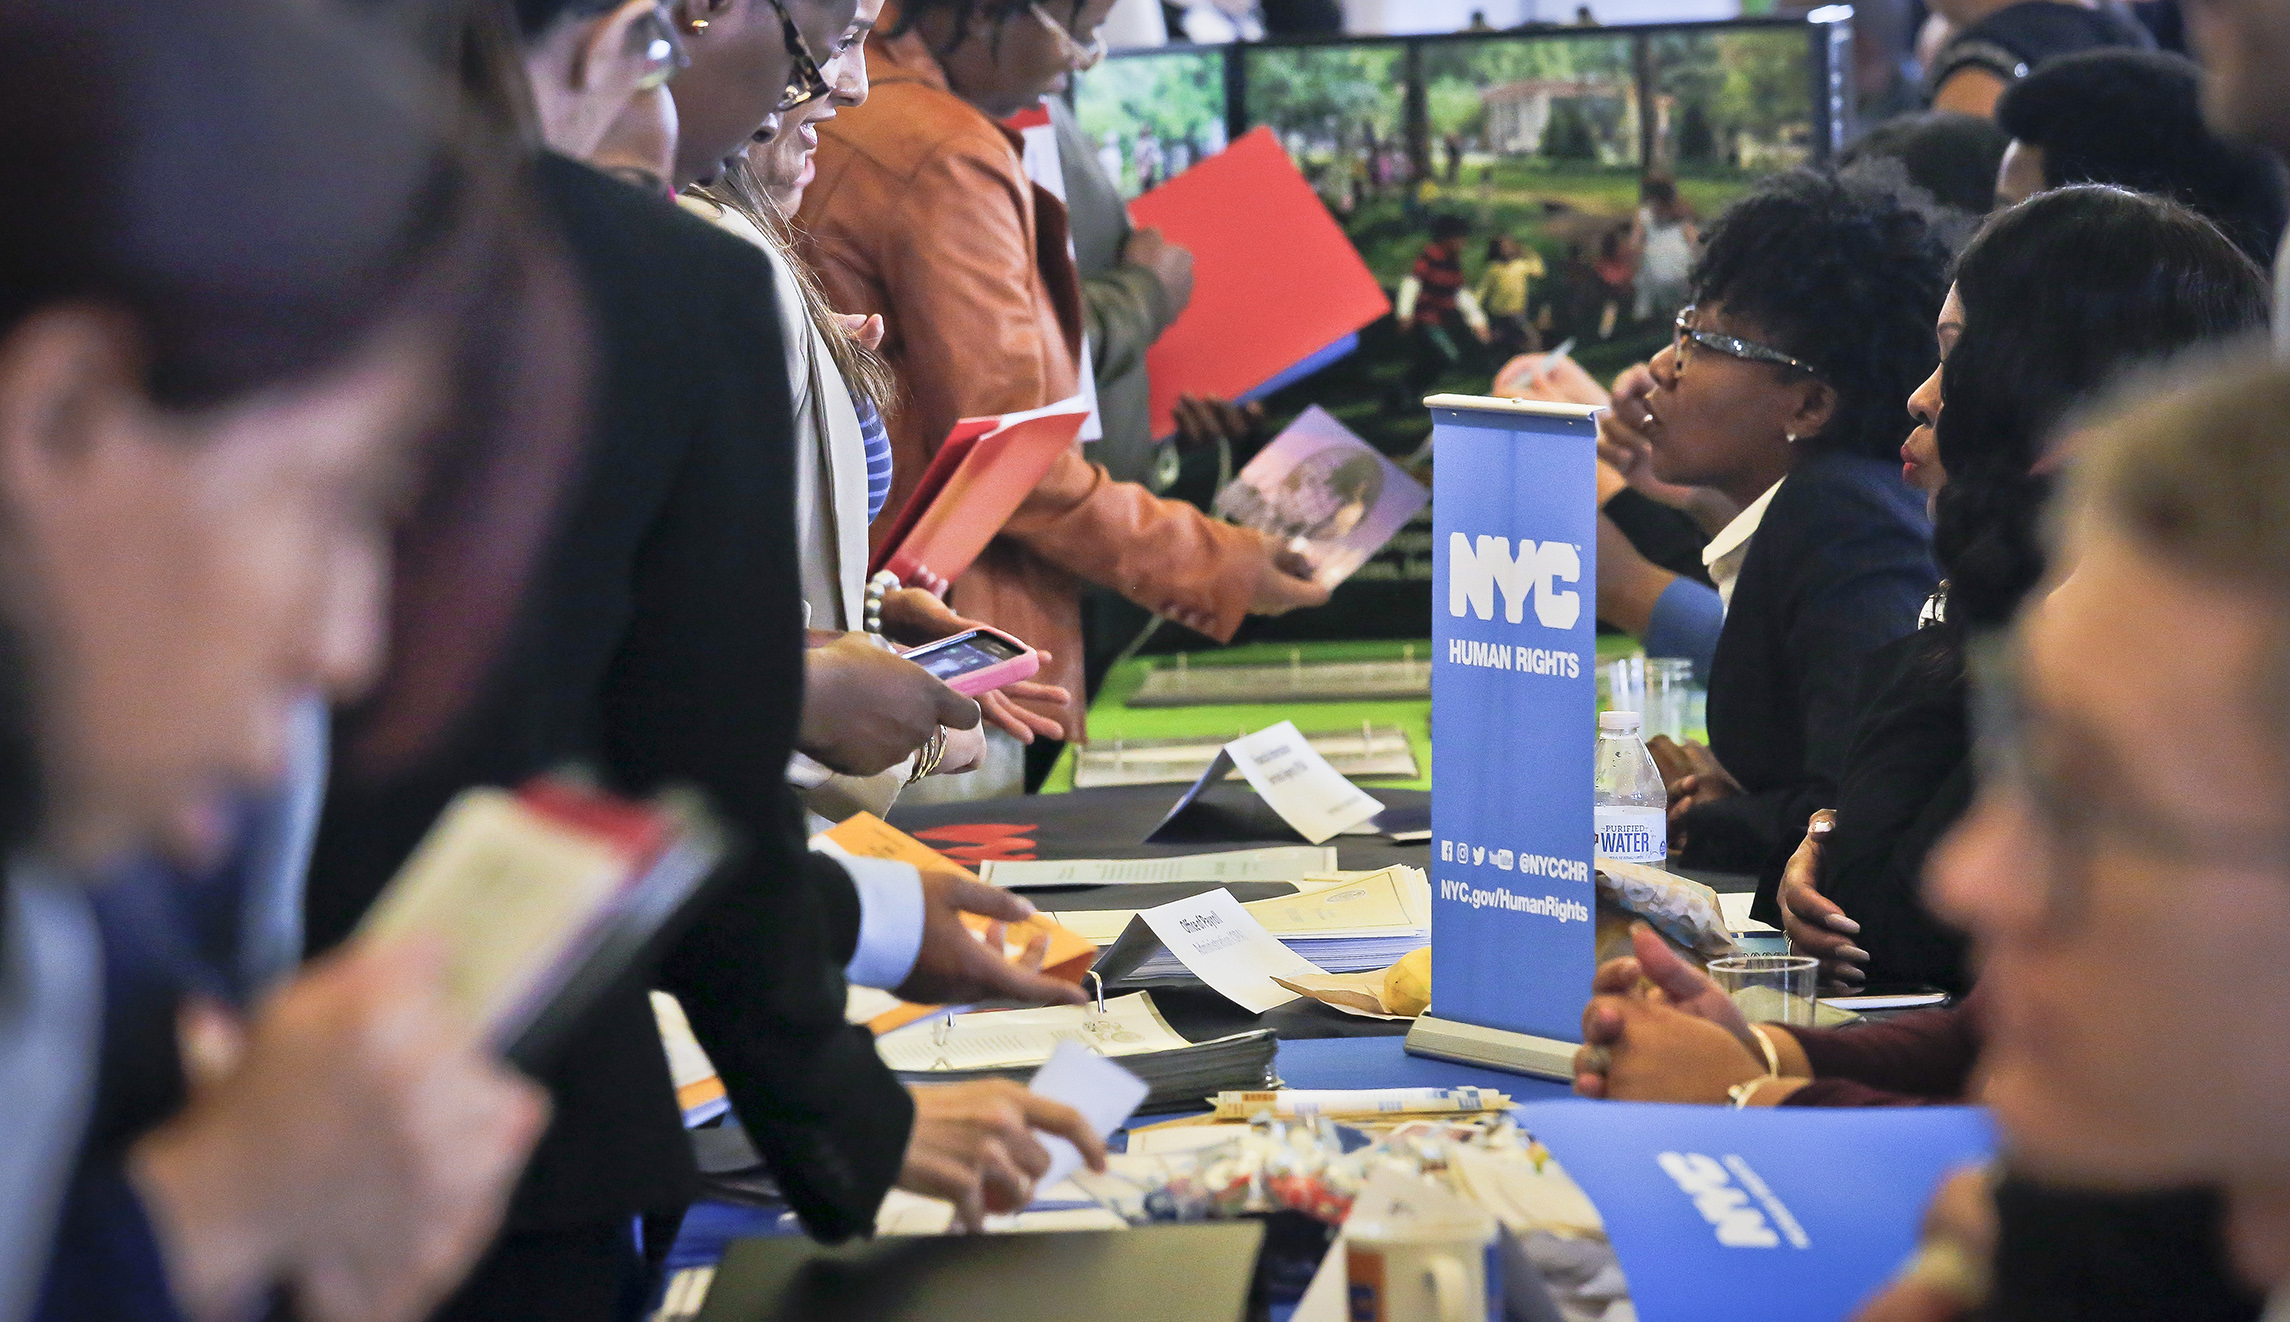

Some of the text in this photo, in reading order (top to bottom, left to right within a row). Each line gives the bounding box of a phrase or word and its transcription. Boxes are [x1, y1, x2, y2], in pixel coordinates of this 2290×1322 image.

[1449, 532, 1580, 630] NYC
[1449, 638, 1580, 679] HUMAN RIGHTS
[1601, 832, 1649, 853] WATER
[1605, 824, 1645, 833] PURIFIED
[1519, 852, 1589, 883] @NYCCHR
[1441, 878, 1589, 923] NYC.gov/HumanRights
